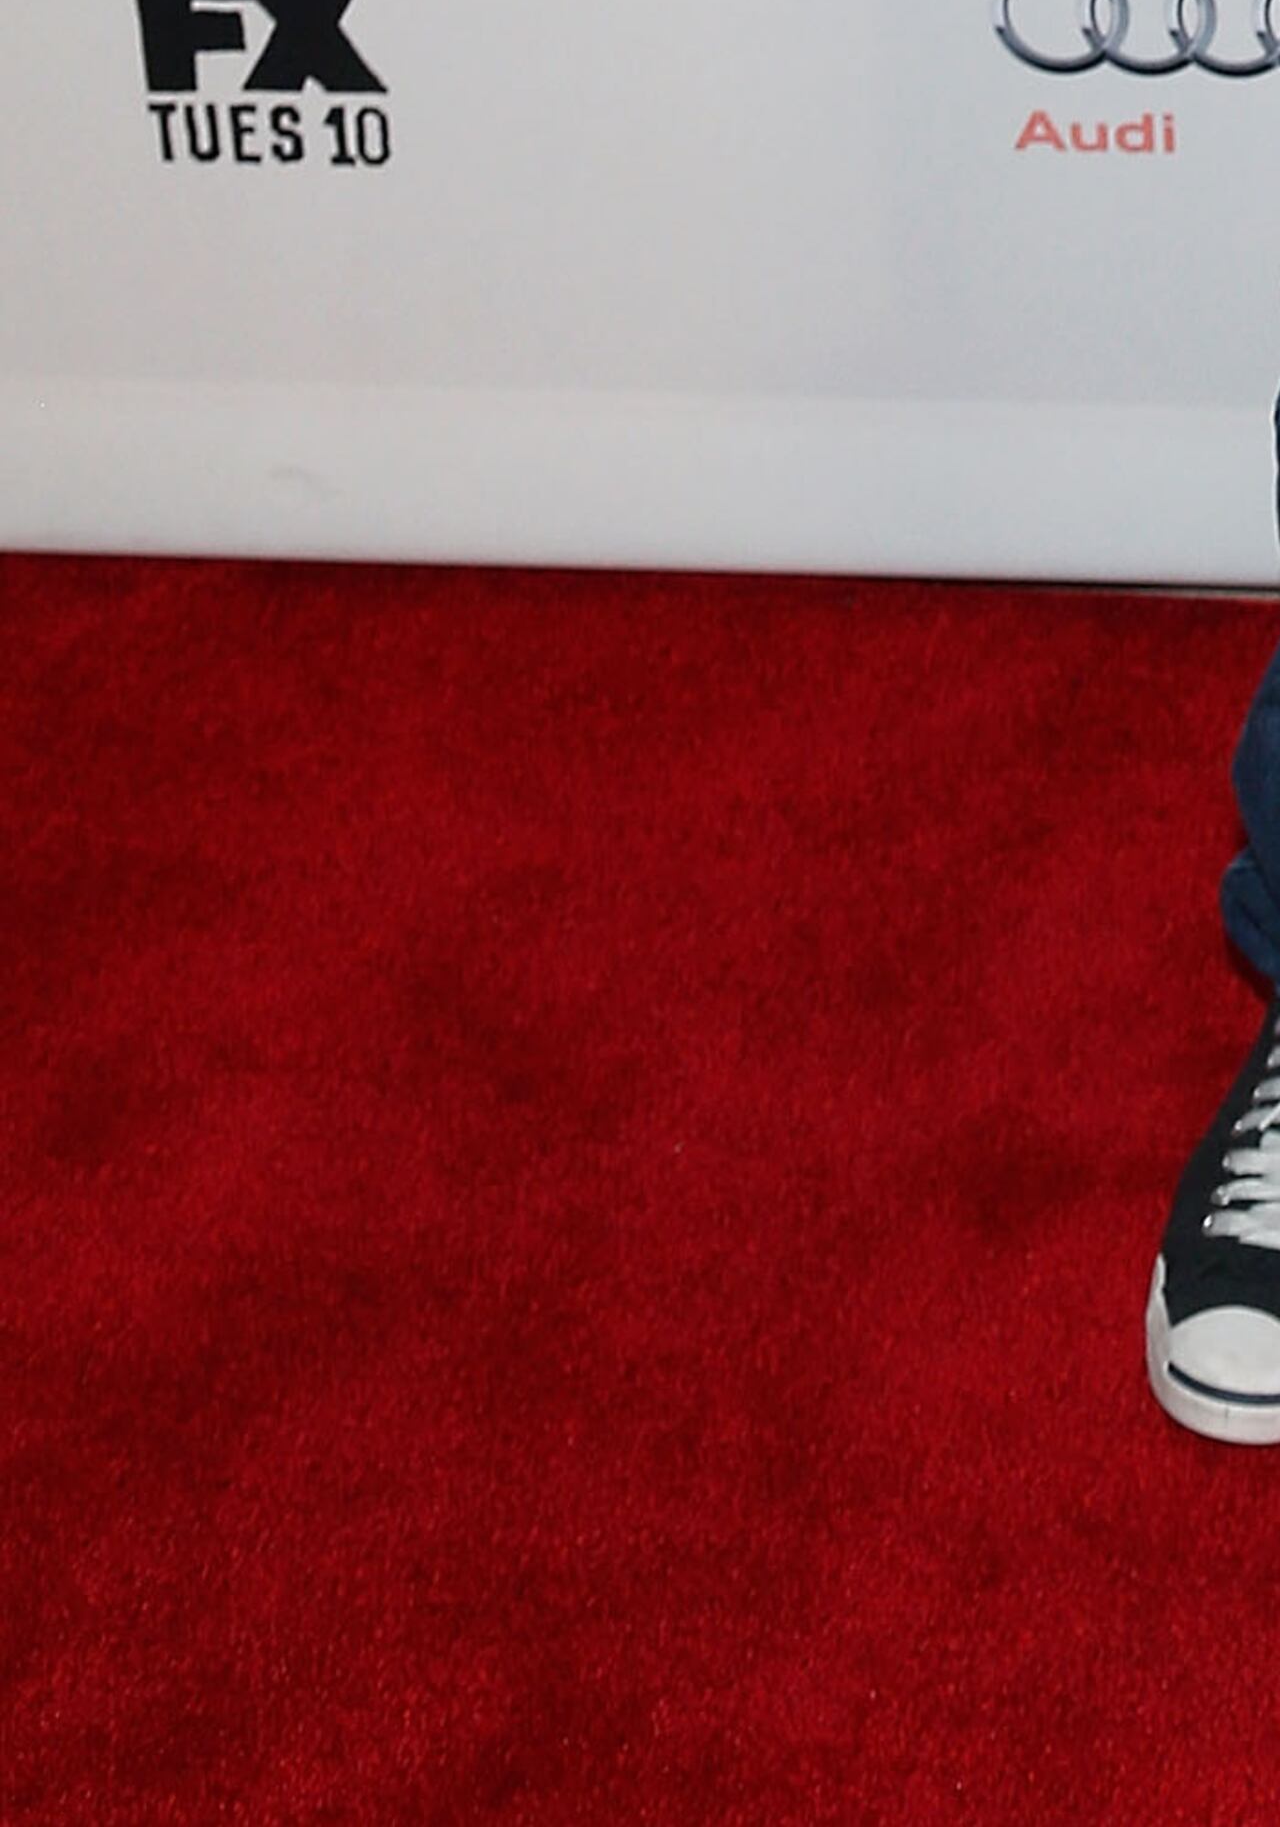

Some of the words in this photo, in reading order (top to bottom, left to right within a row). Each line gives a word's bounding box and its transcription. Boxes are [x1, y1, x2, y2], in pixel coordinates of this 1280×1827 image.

[147, 102, 304, 165] TUES
[323, 105, 392, 167] 10
[1014, 109, 1176, 154] Audi
